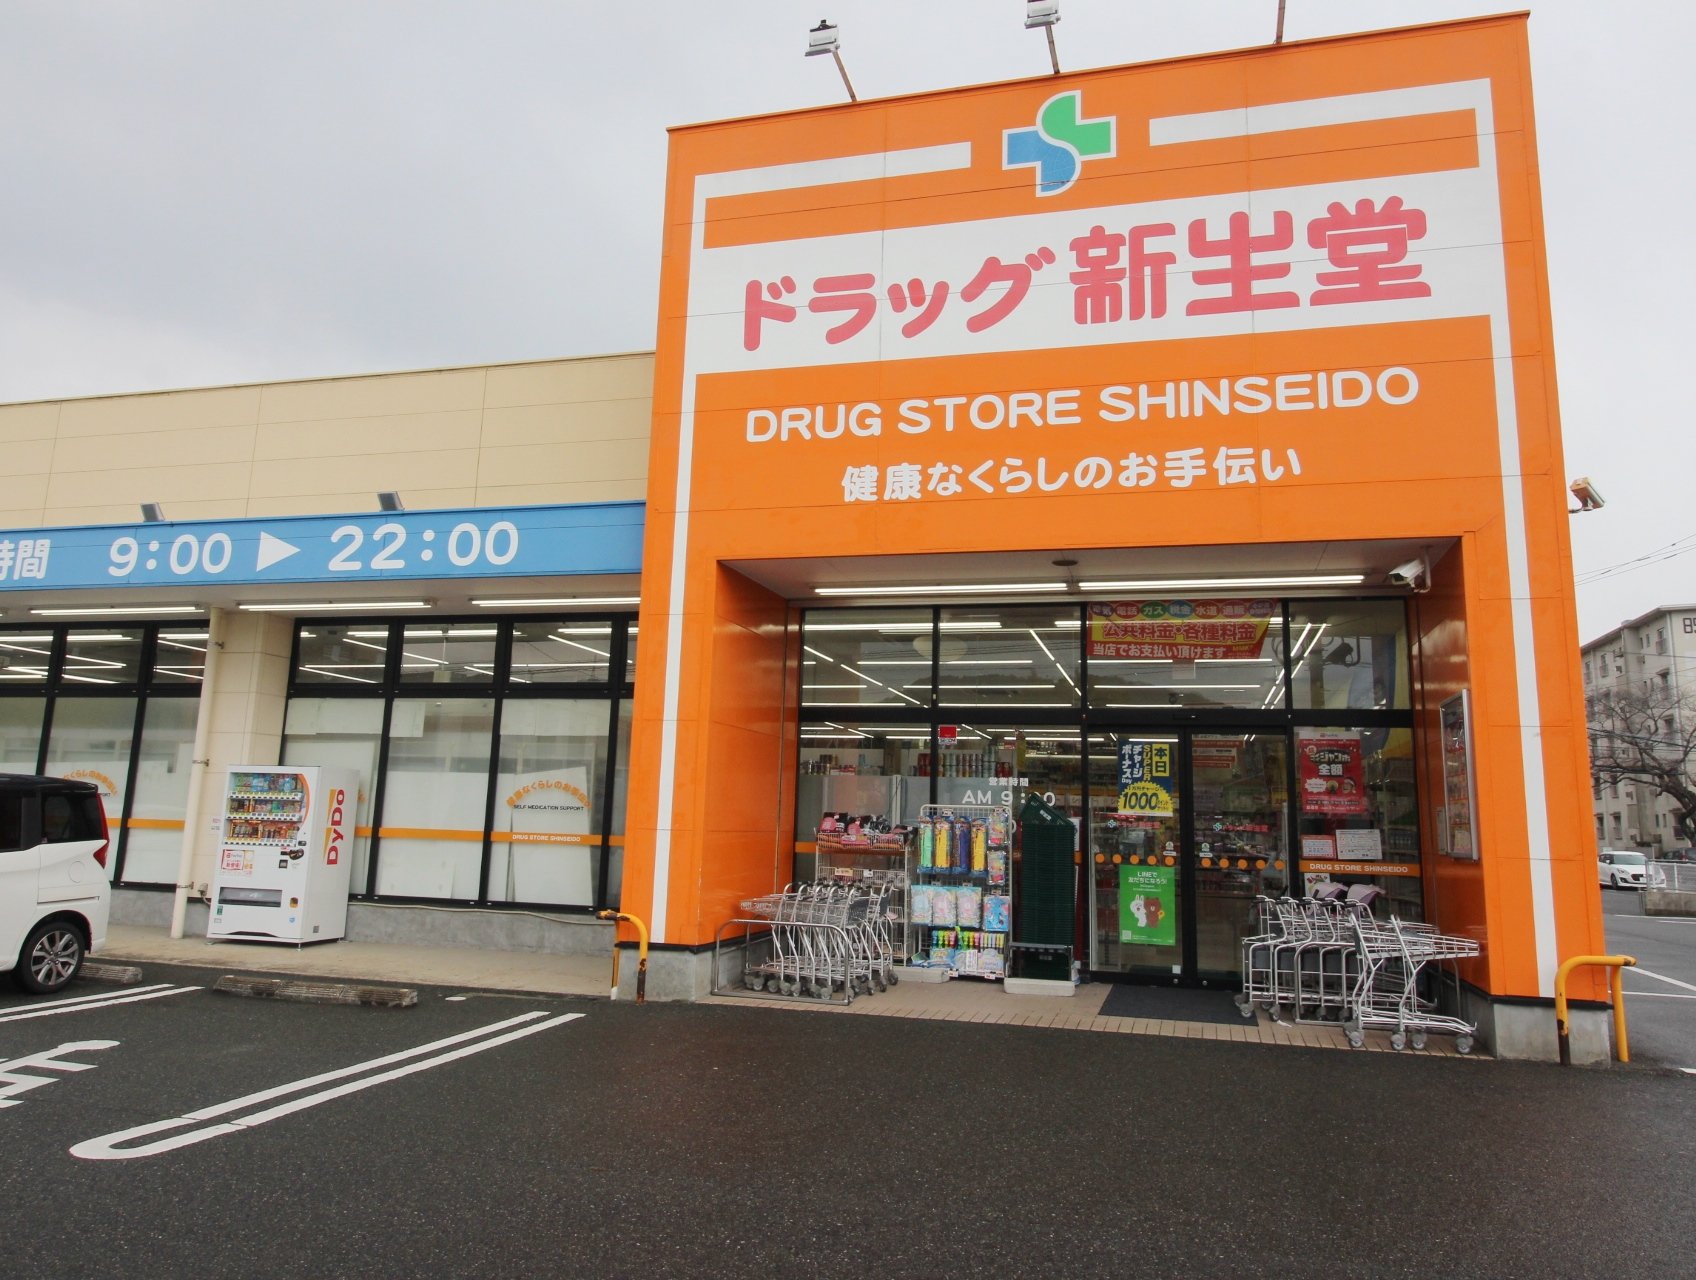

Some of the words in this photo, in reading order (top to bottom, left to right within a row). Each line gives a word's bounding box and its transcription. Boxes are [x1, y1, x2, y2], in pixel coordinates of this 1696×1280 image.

[744, 196, 1432, 351] ドラッグ新生堂
[746, 403, 882, 443] DRUG
[897, 389, 1082, 435] STORE
[1099, 367, 1420, 422] SHINSEIDO
[841, 446, 1302, 502] 健康なくらしのお手伝い
[108, 532, 232, 577] 9:00
[327, 521, 519, 571] 22:00
[1143, 606, 1164, 615] ガス
[1196, 605, 1218, 616] 水道
[1093, 643, 1226, 659] 当店でお支払い頂けます
[1132, 744, 1143, 778] チャージ
[1154, 747, 1168, 774] 本日
[962, 789, 992, 805] AM
[1001, 790, 1056, 807] 9:0
[1122, 791, 1159, 810] 1000
[1364, 865, 1408, 873] SHINSEIDO
